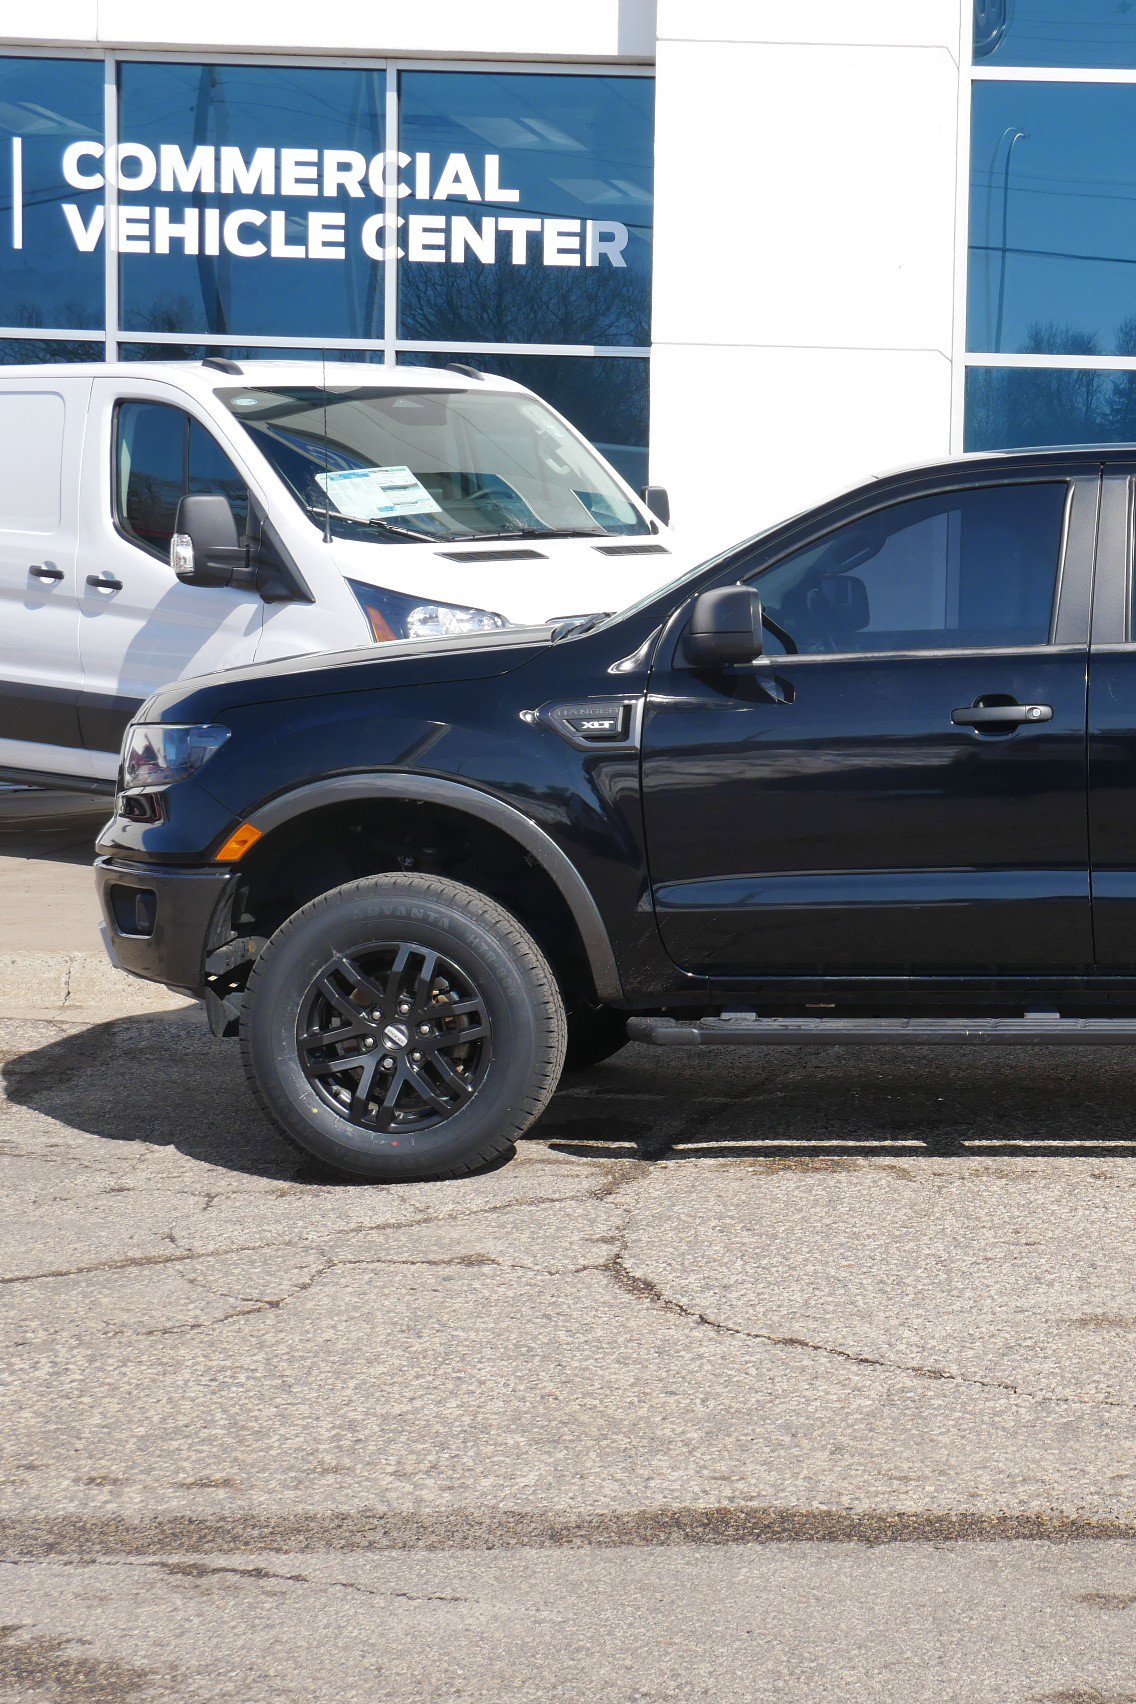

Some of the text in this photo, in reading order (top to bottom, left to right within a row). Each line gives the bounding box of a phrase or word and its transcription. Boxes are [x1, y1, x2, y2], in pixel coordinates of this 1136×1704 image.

[62, 141, 520, 202] COMMERCIAL
[62, 203, 629, 268] VEHICLE CENTER
[580, 720, 615, 729] XLT
